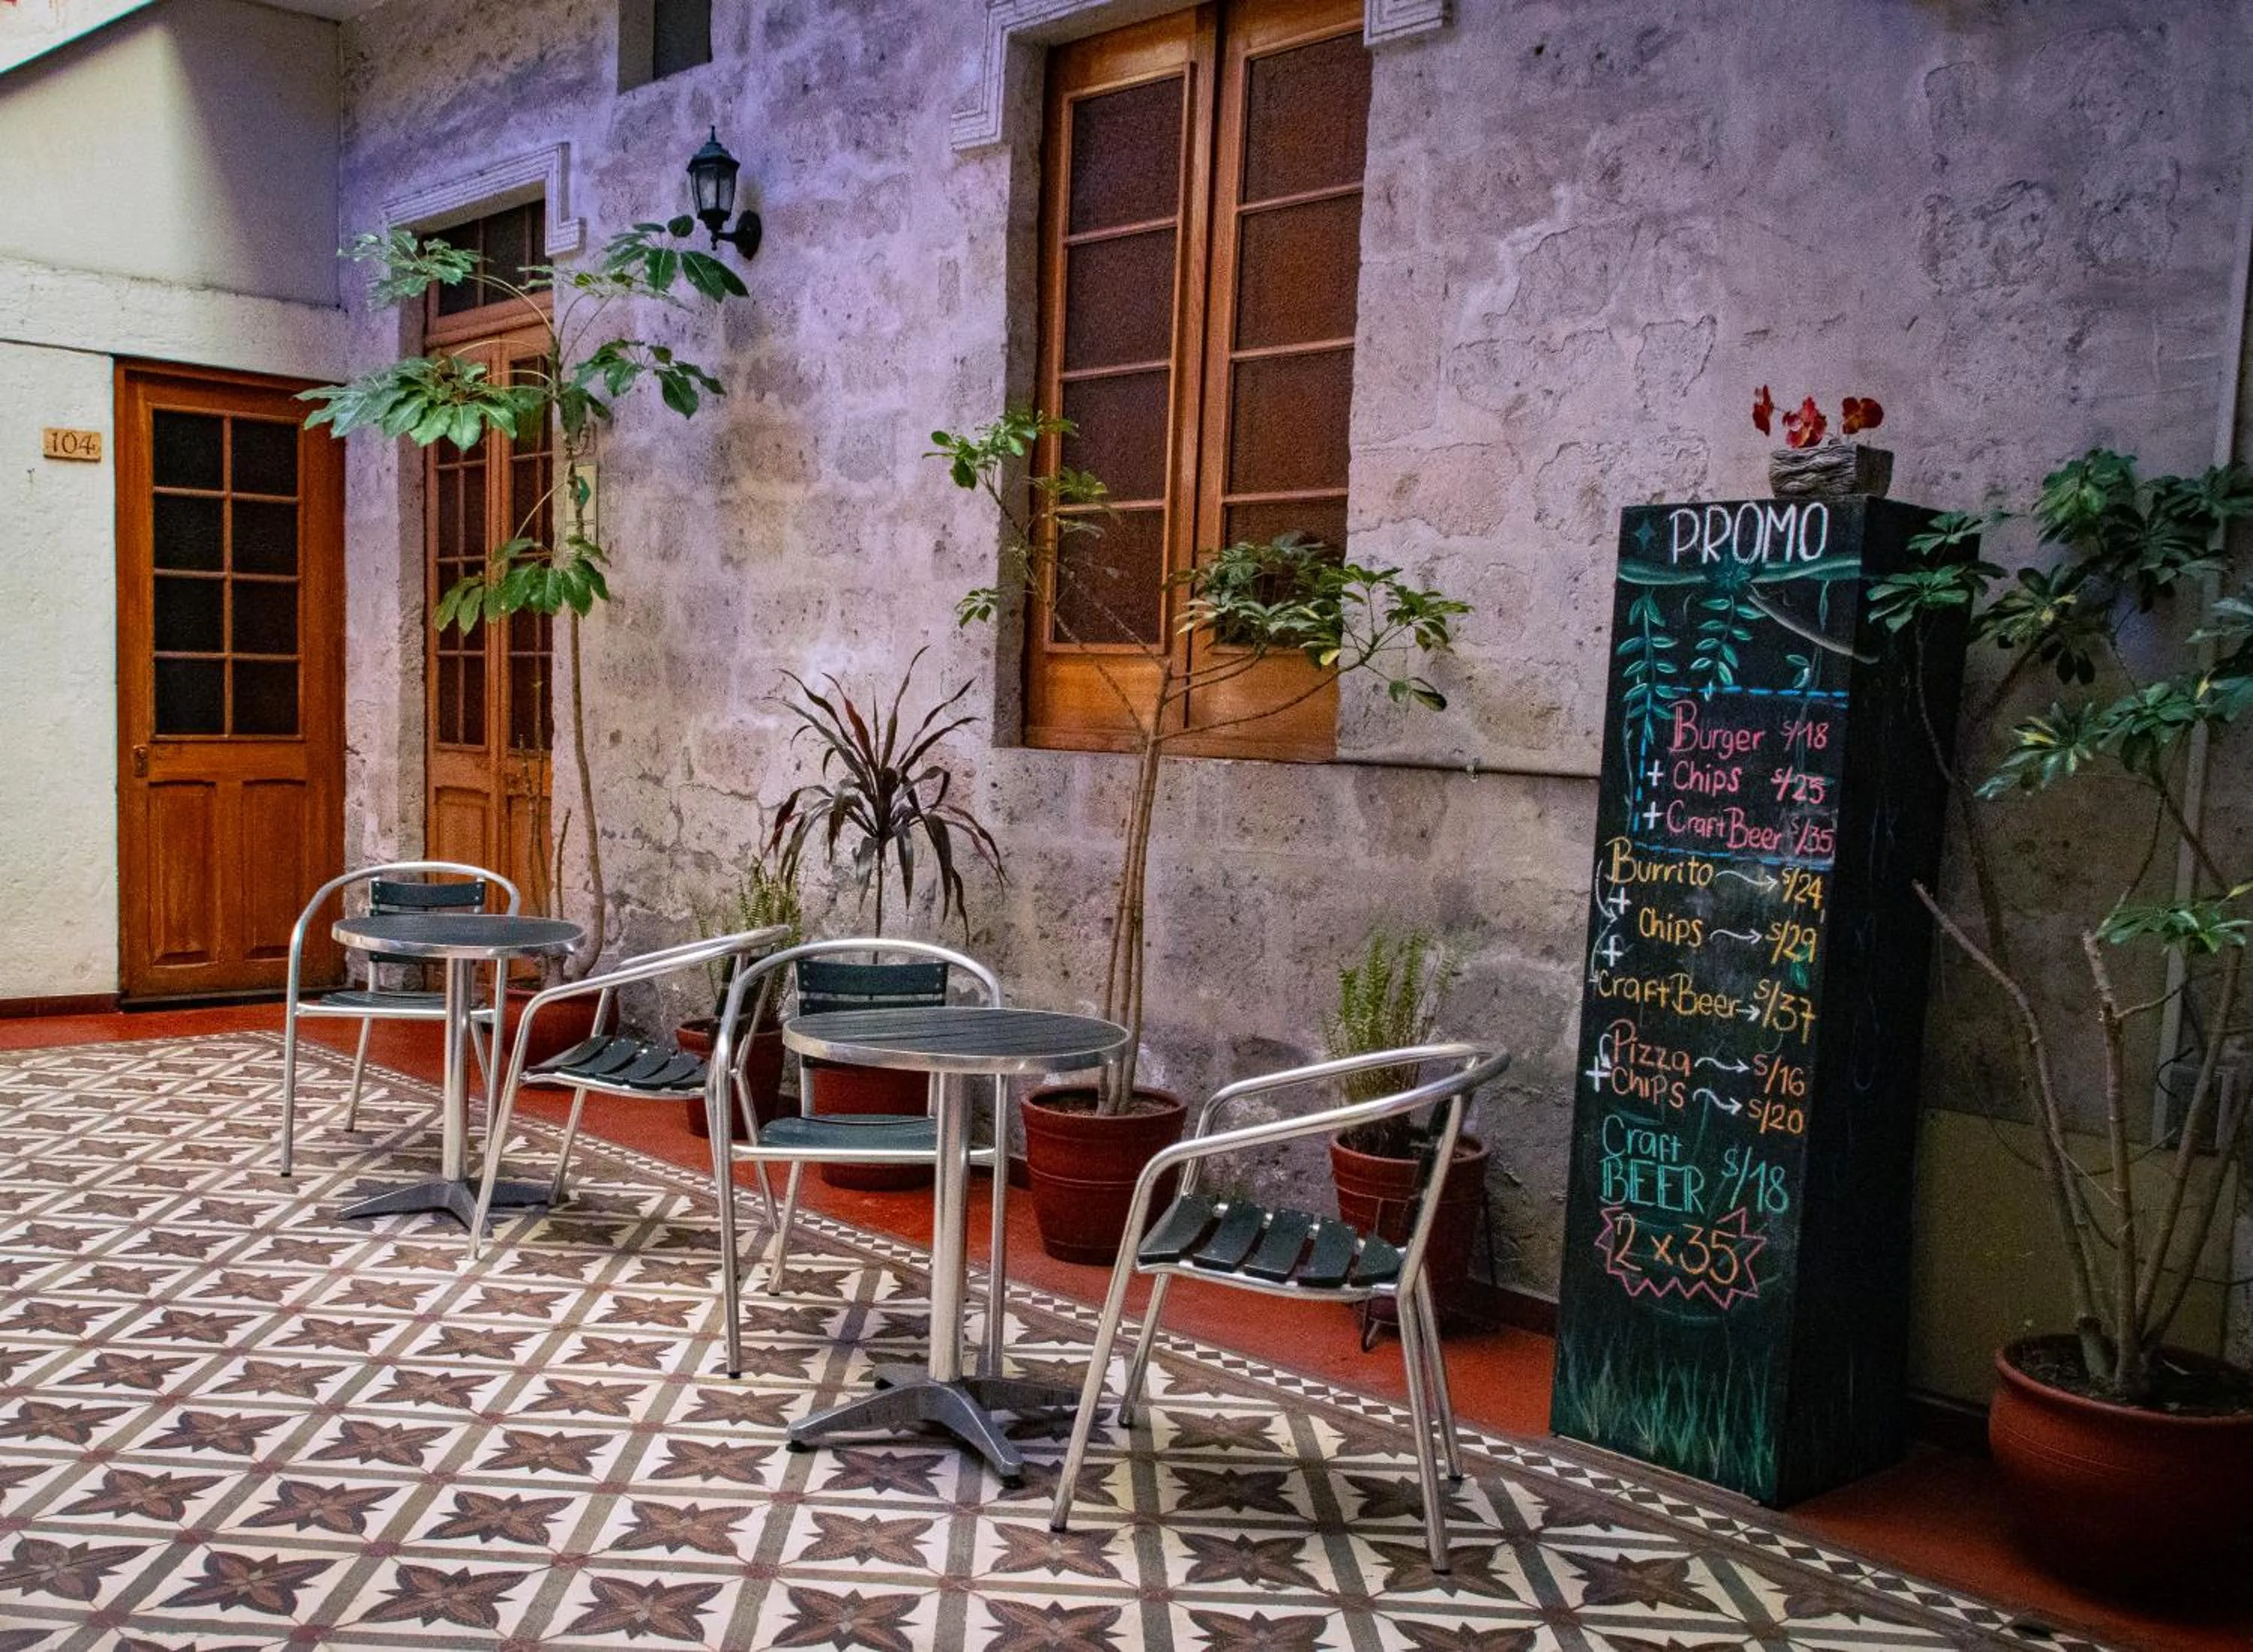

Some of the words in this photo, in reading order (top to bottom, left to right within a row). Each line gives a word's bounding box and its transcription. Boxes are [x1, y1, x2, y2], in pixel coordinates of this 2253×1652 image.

[51, 432, 95, 455] 104
[1669, 502, 1829, 565] PROMO
[1667, 699, 1766, 760] Burger
[1673, 760, 1742, 797] Chips
[1604, 837, 1715, 887] Burrito
[1639, 906, 1703, 948] Chips
[1606, 1018, 1690, 1078] Pizza
[1603, 1114, 1683, 1162] Craft
[1600, 1156, 1705, 1213] BEER
[1721, 1146, 1789, 1213] S/18
[1679, 1223, 1739, 1285] 35
